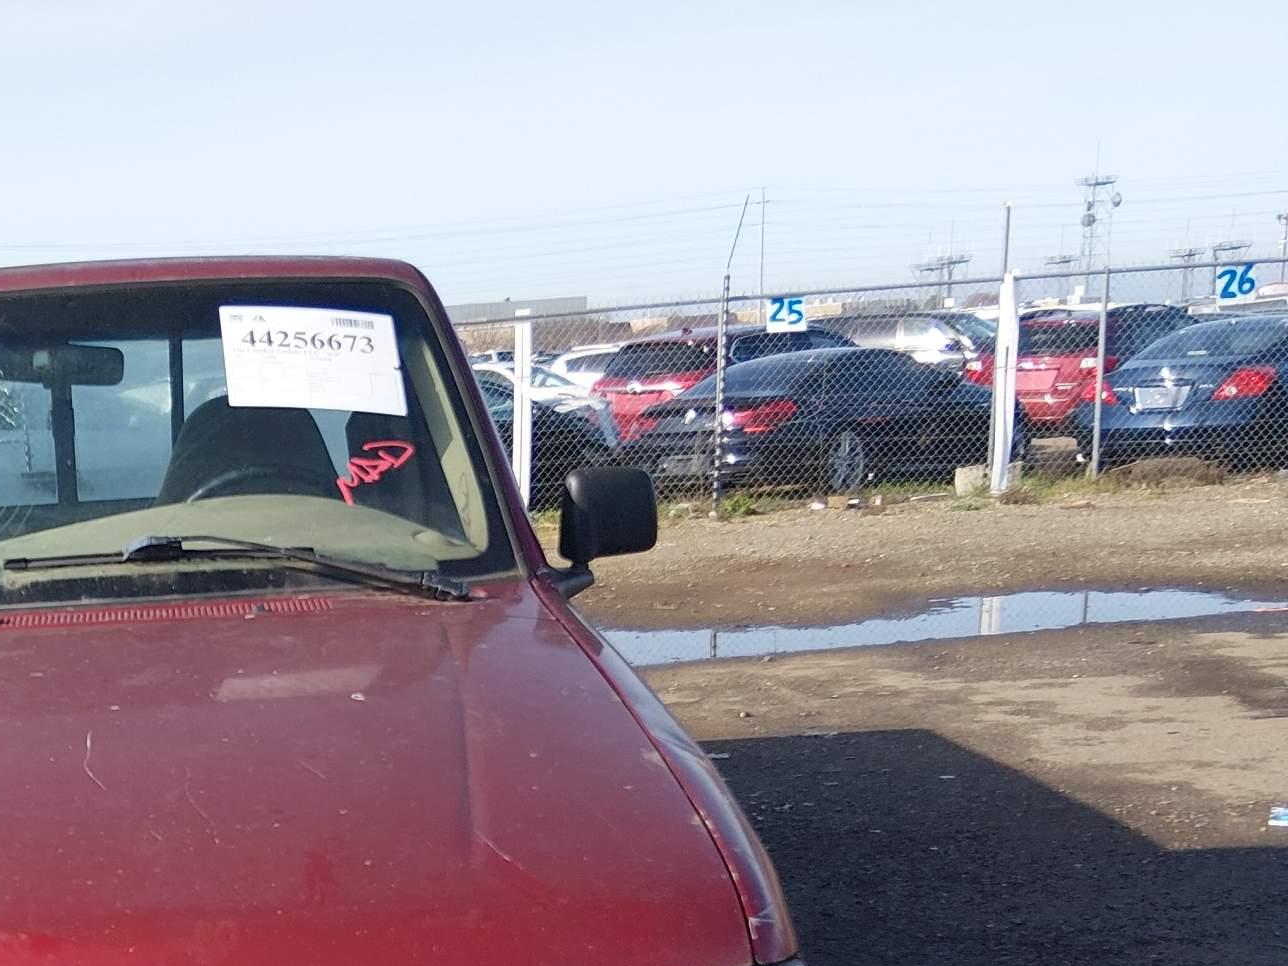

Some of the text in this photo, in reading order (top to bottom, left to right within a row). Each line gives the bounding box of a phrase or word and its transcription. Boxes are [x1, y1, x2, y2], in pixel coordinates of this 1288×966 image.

[1216, 262, 1256, 299] 26
[769, 297, 804, 326] 25
[241, 329, 375, 355] 44256673
